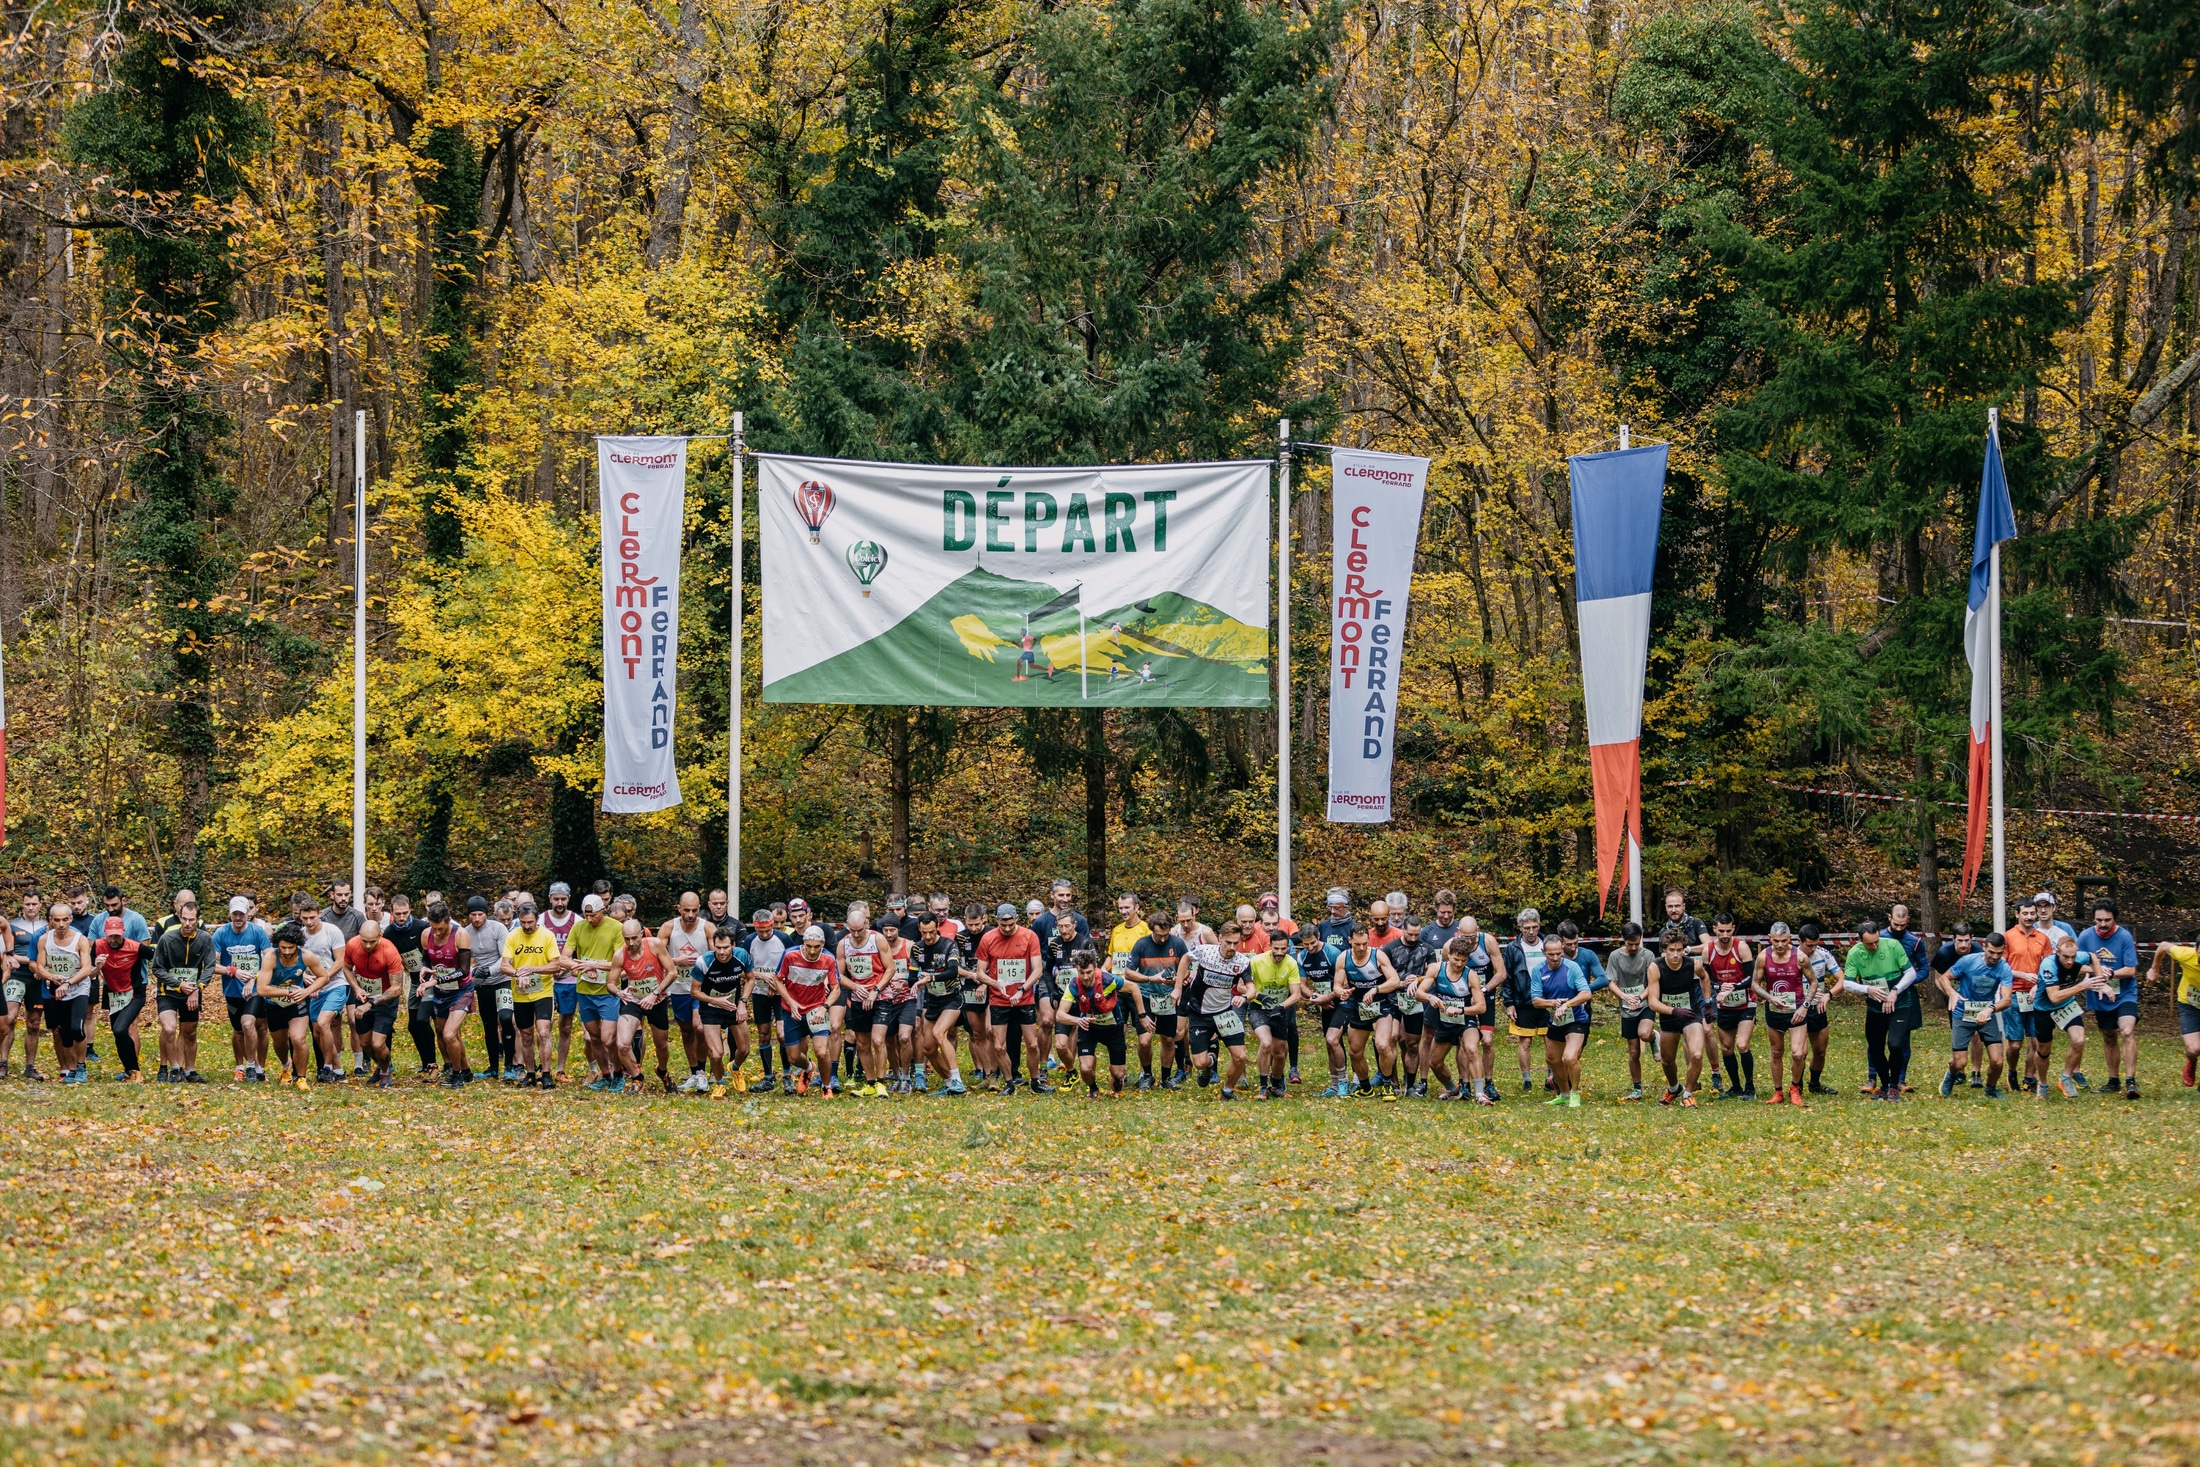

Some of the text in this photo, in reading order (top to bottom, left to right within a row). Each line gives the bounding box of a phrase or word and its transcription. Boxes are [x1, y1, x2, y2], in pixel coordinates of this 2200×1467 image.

[943, 476, 1177, 553] DÉPART
[53, 963, 69, 973] 126
[240, 962, 251, 971] 83
[408, 959, 418, 968] 59
[854, 965, 864, 974] 22
[1007, 968, 1017, 977] 15
[6, 987, 17, 996] 97
[362, 985, 373, 993] 46
[640, 987, 651, 995] 70
[503, 996, 513, 1005] 95
[1159, 1001, 1168, 1010] 32
[2058, 1004, 2073, 1019] 111
[1226, 1020, 1236, 1029] 41
